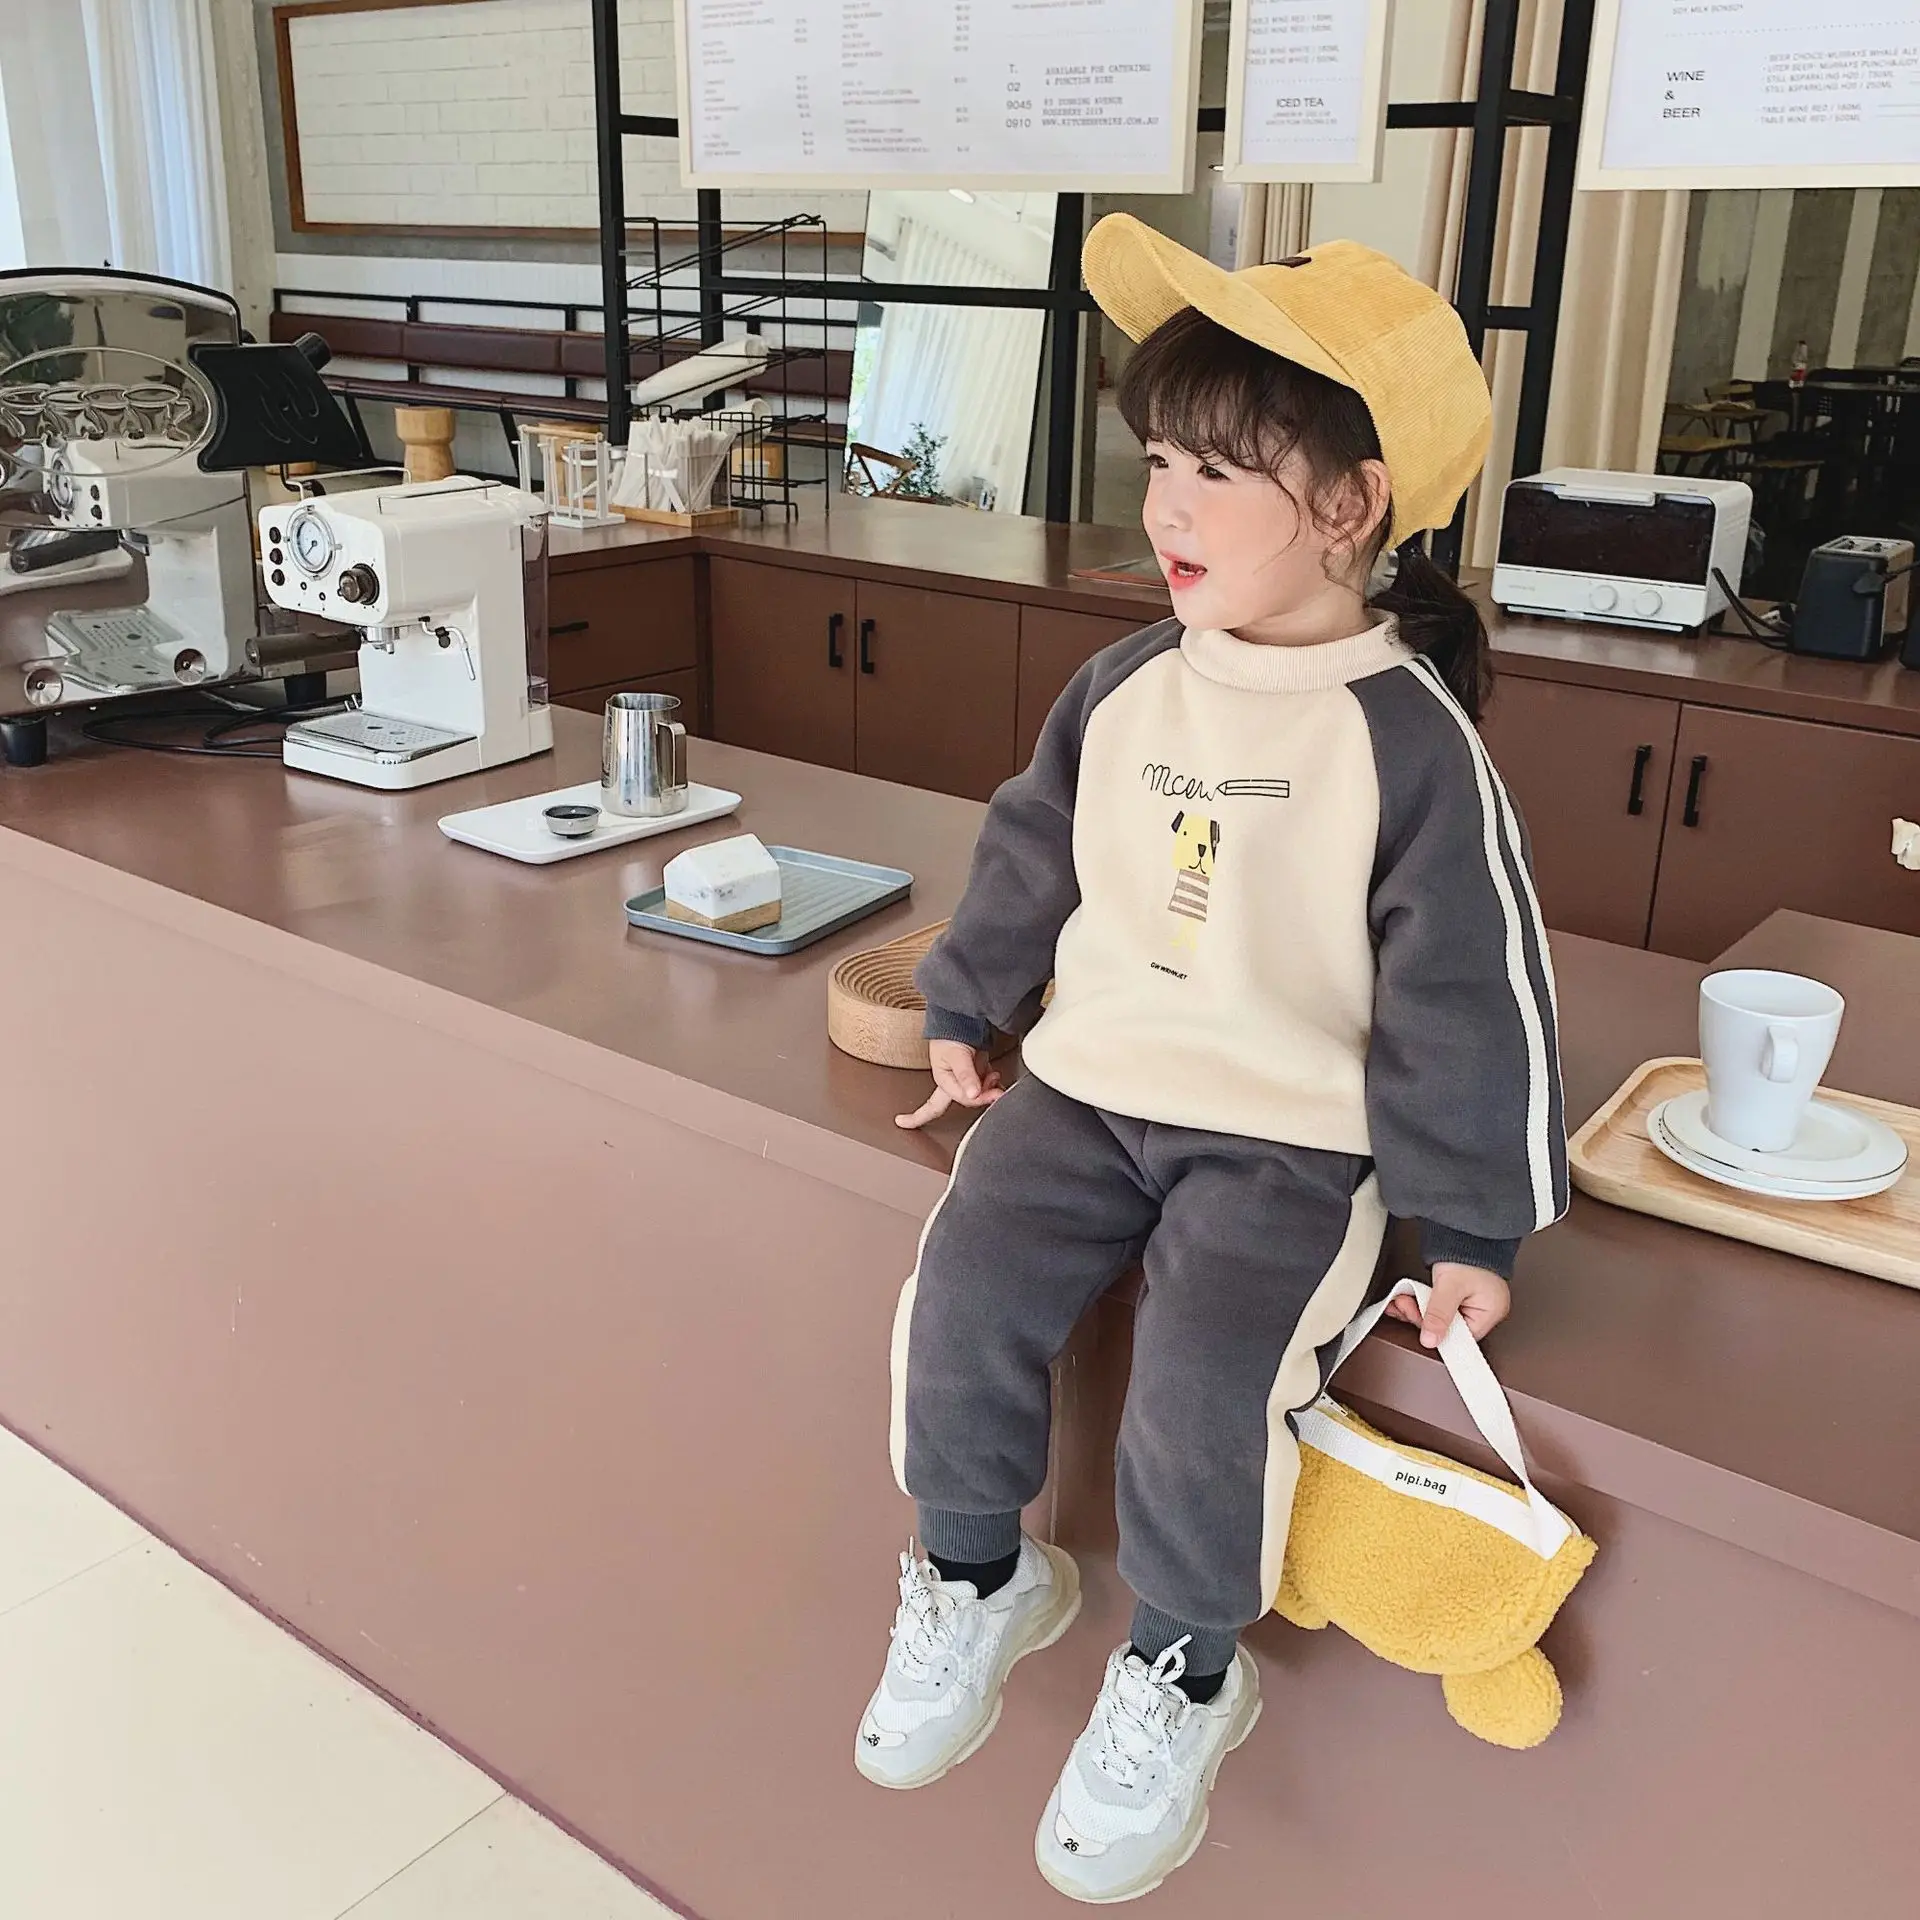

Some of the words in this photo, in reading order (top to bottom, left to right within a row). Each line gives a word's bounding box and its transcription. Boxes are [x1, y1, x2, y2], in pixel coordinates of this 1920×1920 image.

[1666, 70, 1705, 82] WINE
[1006, 82, 1021, 92] 02
[1664, 89, 1675, 101] &
[1006, 100, 1033, 110] 9045
[1276, 98, 1301, 108] ICED
[1304, 97, 1324, 107] TEA
[1663, 106, 1701, 118] BEER
[1005, 118, 1031, 129] 0910
[1395, 1471, 1447, 1495] pipi.bag
[867, 1733, 881, 1747] 26
[1063, 1837, 1080, 1852] 26
